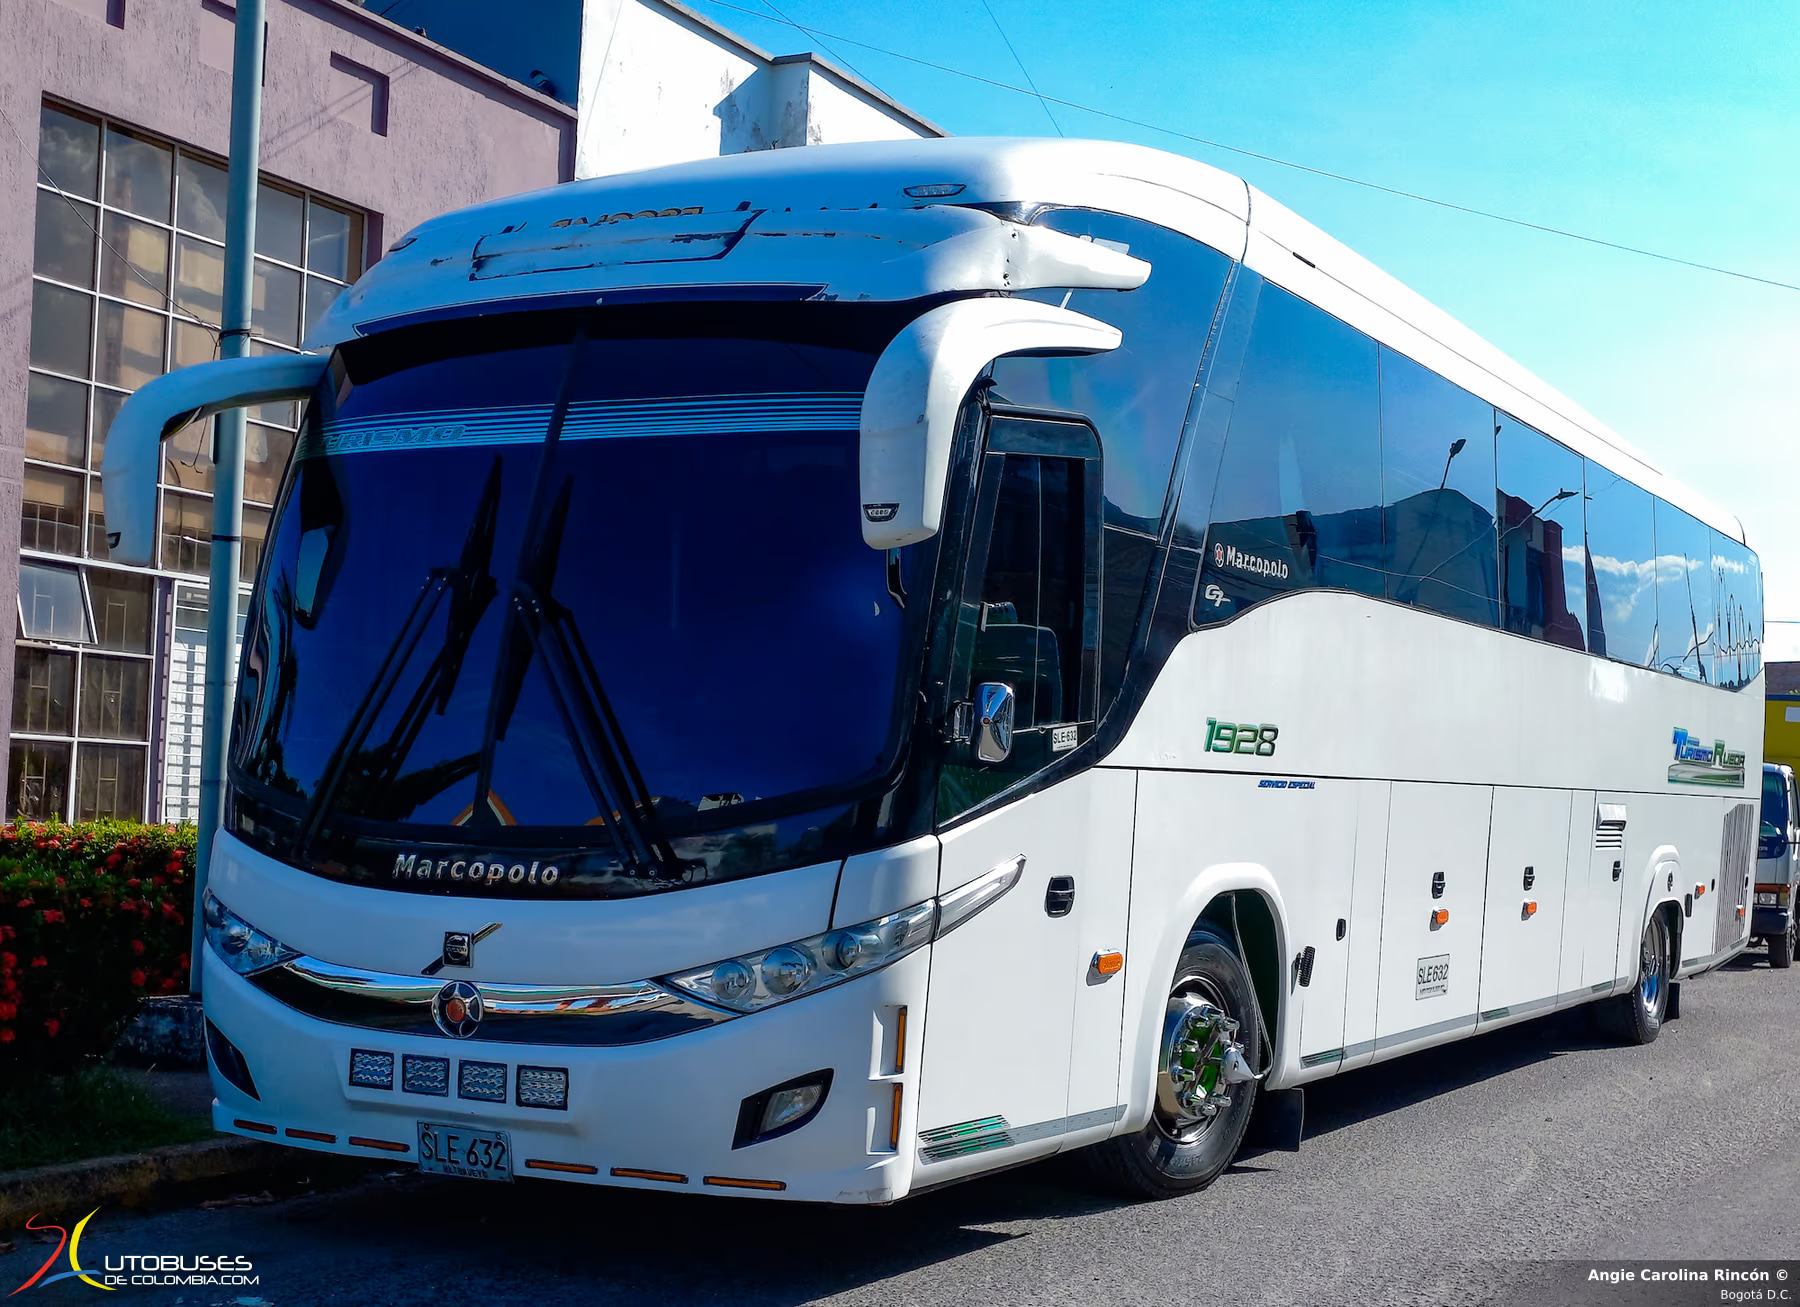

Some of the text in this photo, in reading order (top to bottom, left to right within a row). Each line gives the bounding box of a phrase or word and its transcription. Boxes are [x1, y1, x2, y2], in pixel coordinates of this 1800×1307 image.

[321, 424, 467, 450] URISMO
[1226, 545, 1288, 579] Marcopolo
[1203, 716, 1279, 756] 1928
[392, 853, 558, 885] Marcopolo
